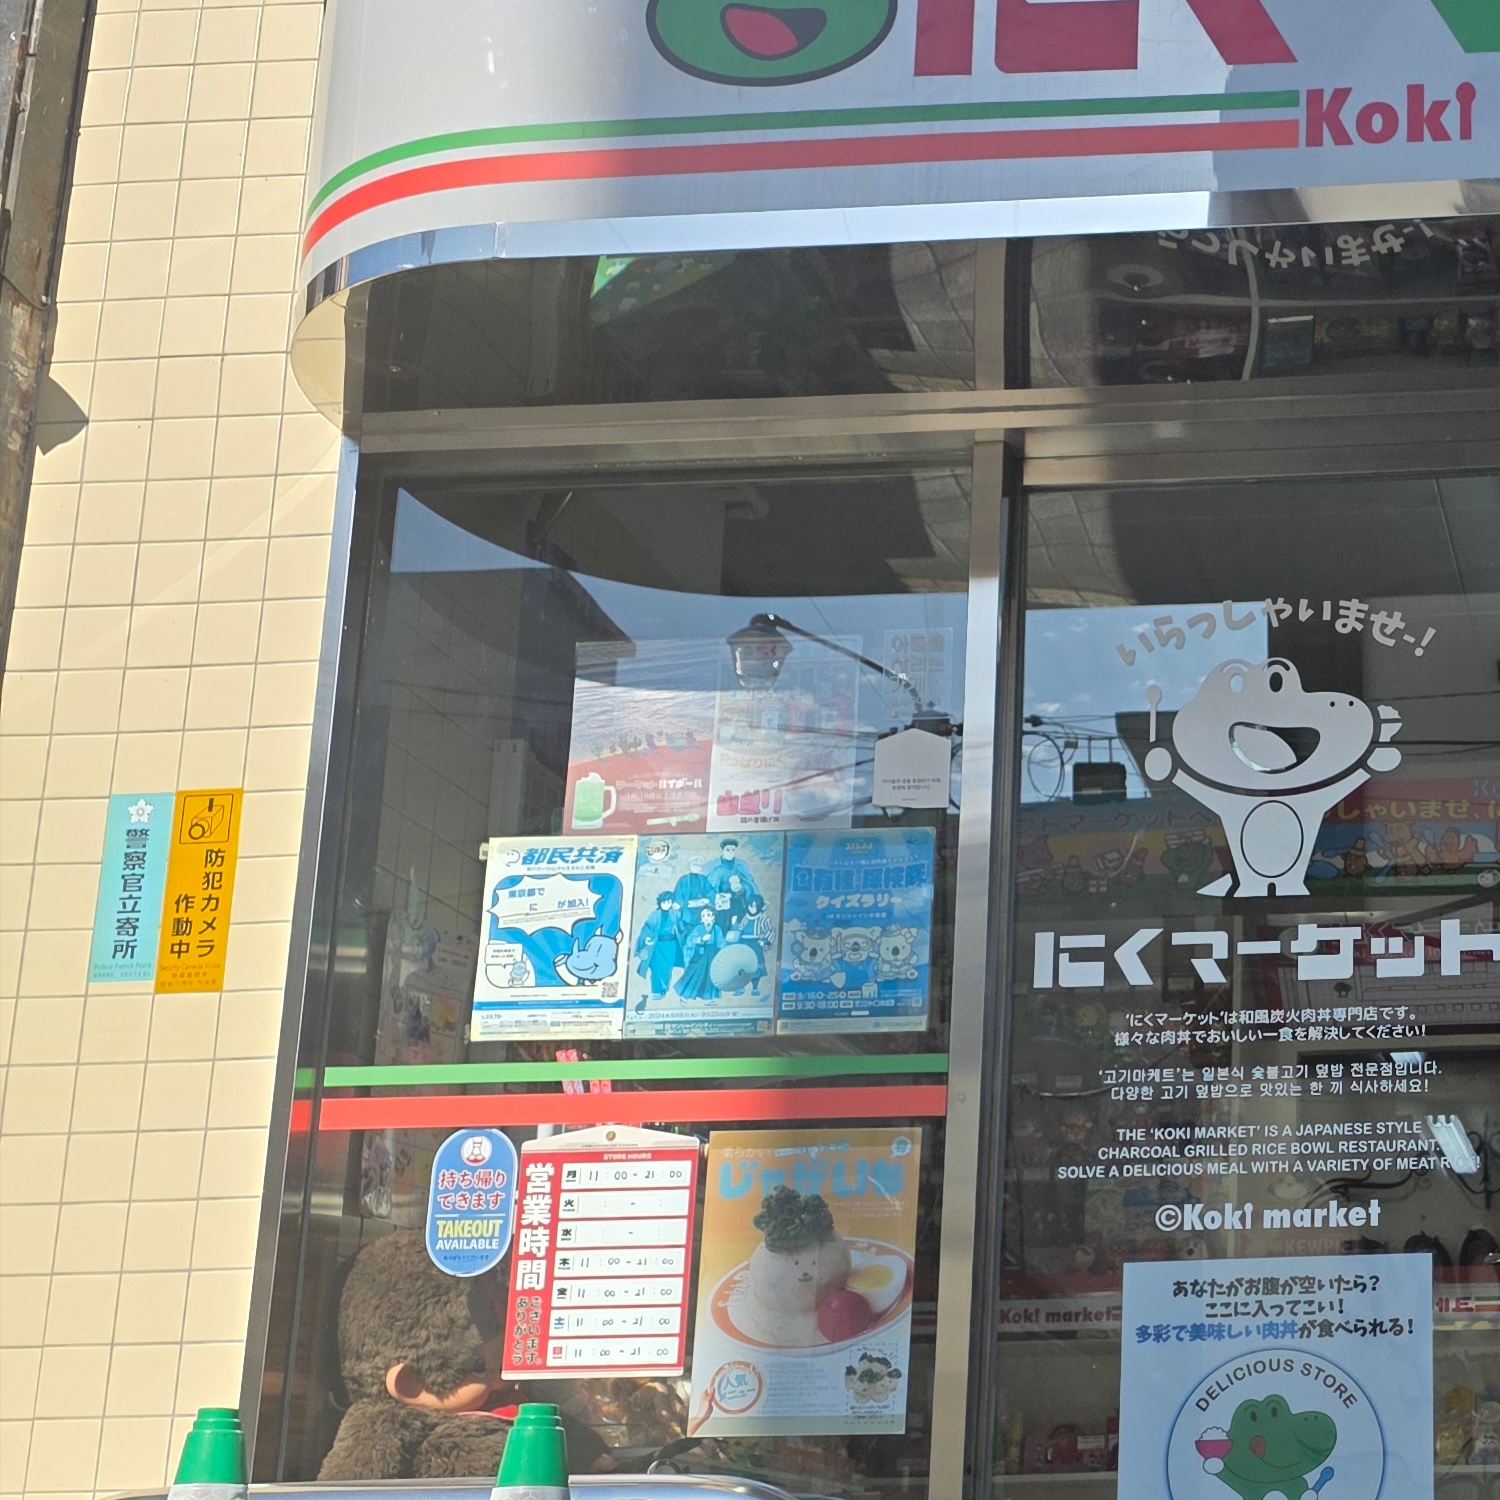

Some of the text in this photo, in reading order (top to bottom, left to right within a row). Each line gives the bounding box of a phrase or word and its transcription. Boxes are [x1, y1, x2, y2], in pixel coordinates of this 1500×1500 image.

[1305, 82, 1477, 148] Koki
[520, 846, 626, 867] 都民共済
[112, 828, 150, 960] 警察官立寄所
[196, 848, 226, 958] 防犯カメラ
[508, 887, 545, 899] 東京都で
[815, 893, 903, 910] クイズラリー
[170, 893, 196, 960] 作動中
[1202, 1065, 1245, 1083] 일본식
[1251, 1063, 1309, 1081] 숯불고기
[1315, 1062, 1344, 1080] 덮밥
[1350, 1059, 1443, 1078] 전문점입니다.
[1110, 1078, 1429, 1101] 다양한 고기 덮밥으로 맛있는 한 끼 식사하세요!
[1116, 1128, 1147, 1142] THE
[1263, 1124, 1279, 1138] IS
[1280, 1124, 1293, 1137] A
[1295, 1122, 1373, 1137] JAPANESE
[1375, 1121, 1423, 1136] STYLE
[1097, 1138, 1441, 1161] CHARCOAL GRILLED RICE BOWL RESTAURANT.
[566, 1170, 578, 1180] 月
[1057, 1165, 1106, 1181] SOLVE
[1108, 1165, 1121, 1179] A
[1122, 1162, 1204, 1178] DELICIOUS
[1206, 1161, 1248, 1176] MEAL
[1251, 1160, 1290, 1175] WITH
[1291, 1160, 1304, 1174] A
[1305, 1158, 1370, 1174] VARIETY
[1371, 1157, 1394, 1172] OF
[1395, 1156, 1439, 1171] MEAT
[438, 1170, 507, 1190] 持ち帰り
[437, 1191, 506, 1211] できます
[563, 1199, 575, 1208] 火
[1262, 1198, 1382, 1230] market
[436, 1219, 504, 1239] TAKEOUT
[515, 1162, 556, 1292] 営業時間
[560, 1228, 573, 1237] 水
[435, 1238, 500, 1251] AVAILABLE
[558, 1257, 571, 1267] 木
[556, 1287, 568, 1297] 金
[1172, 1273, 1382, 1299] あなたがお腹が空いたら?
[1000, 1306, 1114, 1325] Koki market
[1204, 1298, 1345, 1318] ここに入ってこい!
[553, 1317, 565, 1327] 土
[1135, 1318, 1415, 1344] 多彩で美味しい肉丼が食べられる!
[552, 1345, 564, 1356] 日
[1195, 1357, 1360, 1414] DELICIOUS STORE
